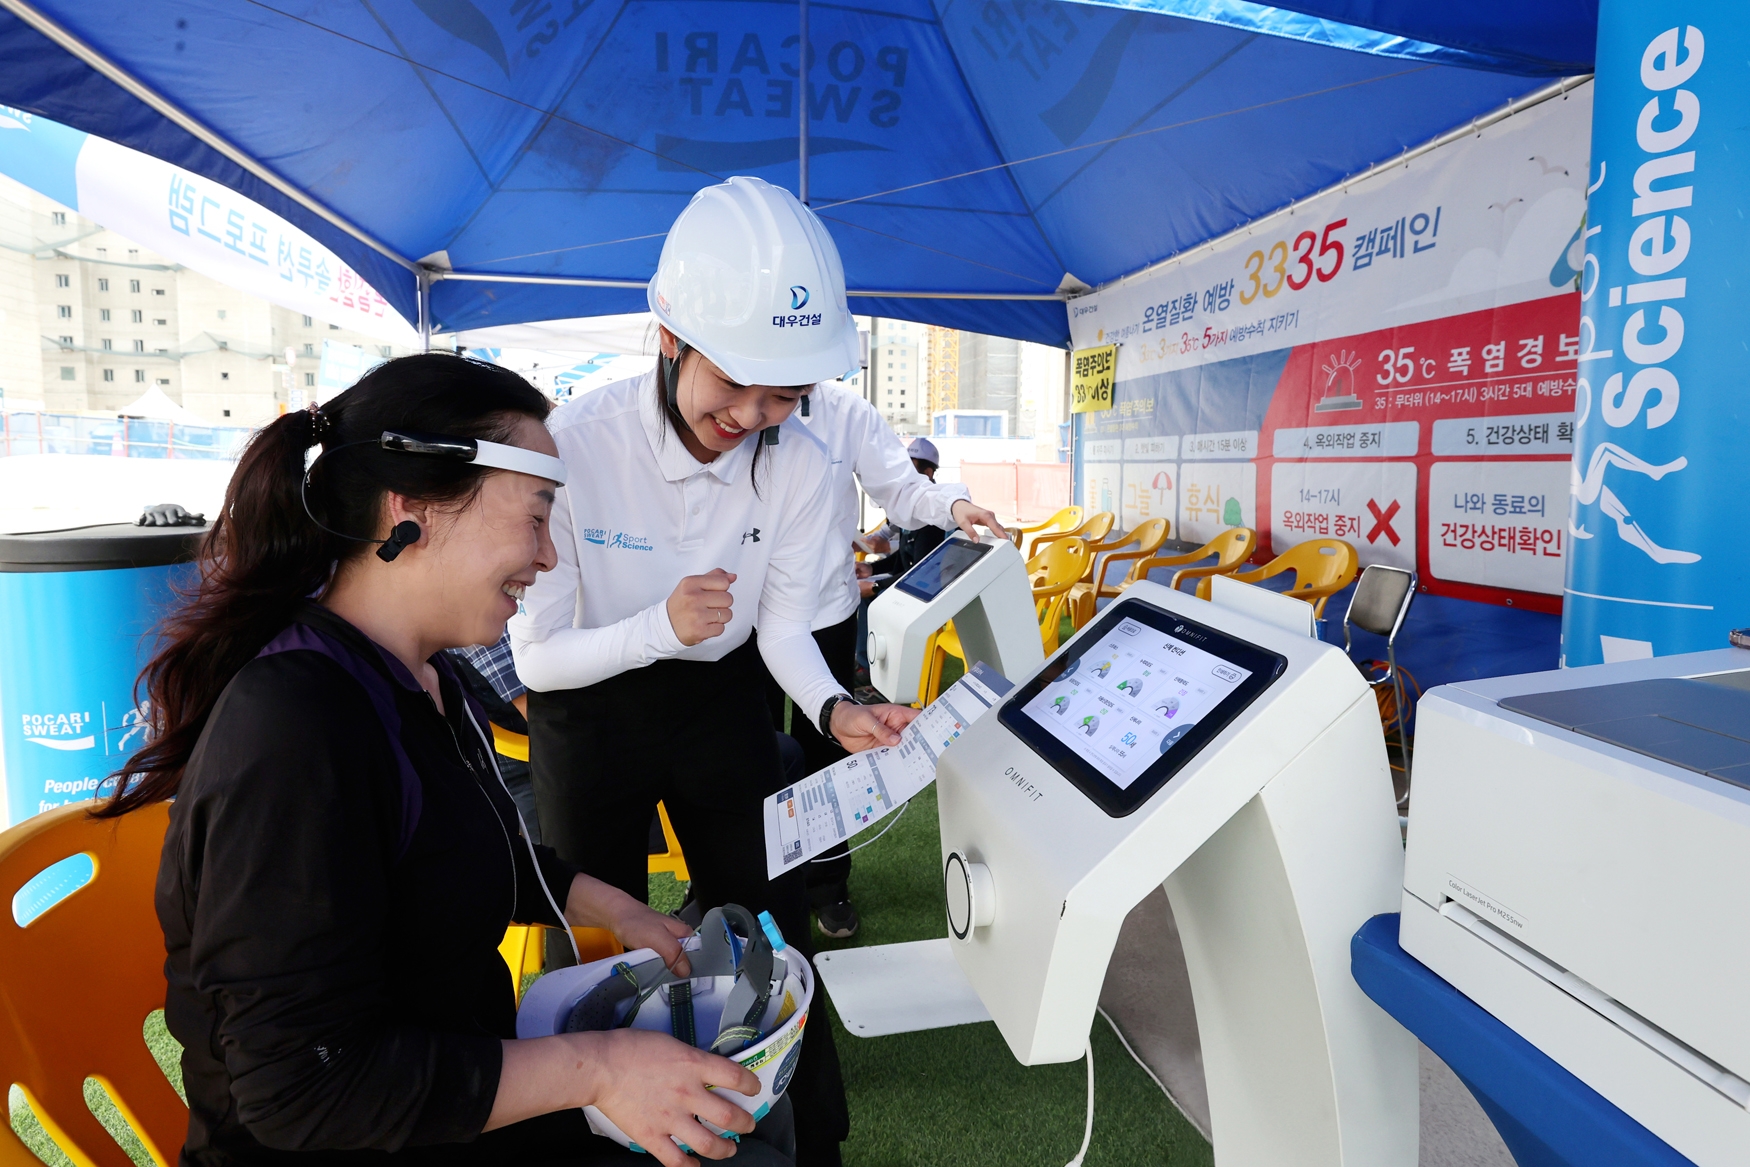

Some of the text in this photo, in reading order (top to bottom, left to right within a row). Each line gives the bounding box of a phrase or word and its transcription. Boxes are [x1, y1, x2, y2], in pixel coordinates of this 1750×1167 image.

[1601, 24, 1706, 429] Science
[1142, 291, 1199, 333] 온열질환
[1202, 278, 1235, 315] 예방
[1239, 217, 1348, 306] 3335
[1352, 206, 1442, 272] 캠페인
[772, 313, 822, 328] 대우건설
[1202, 326, 1228, 349] 5가지
[1229, 319, 1266, 342] 예방수칙
[1267, 310, 1300, 333] 지키기
[1375, 397, 1386, 410] 35
[1395, 392, 1423, 409] 무더위
[1480, 383, 1510, 402] 3시간
[1513, 382, 1533, 399] 5대
[1217, 439, 1231, 452] 15분
[1233, 437, 1248, 451] 이상
[1303, 431, 1382, 450] 4. 옥외작업 중지
[1466, 428, 1479, 446] 5.
[1485, 422, 1549, 446] 건강상태
[1125, 481, 1152, 517] 그늘
[1185, 483, 1221, 525] 휴식
[1454, 492, 1546, 518] 나와 동료의
[1283, 510, 1361, 538] 옥외작업 중지
[622, 541, 653, 551] Science
[623, 533, 647, 544] Sport
[1441, 522, 1562, 558] 건강상태확인
[1181, 628, 1208, 642] OMNIFIT
[22, 711, 90, 726] POCARI
[23, 722, 84, 736] SWEAT
[44, 777, 99, 796] People
[1004, 766, 1044, 802] OMNIFIT
[1448, 879, 1463, 893] Color
[1486, 902, 1497, 914] Pro
[1497, 908, 1523, 929] M255nw
